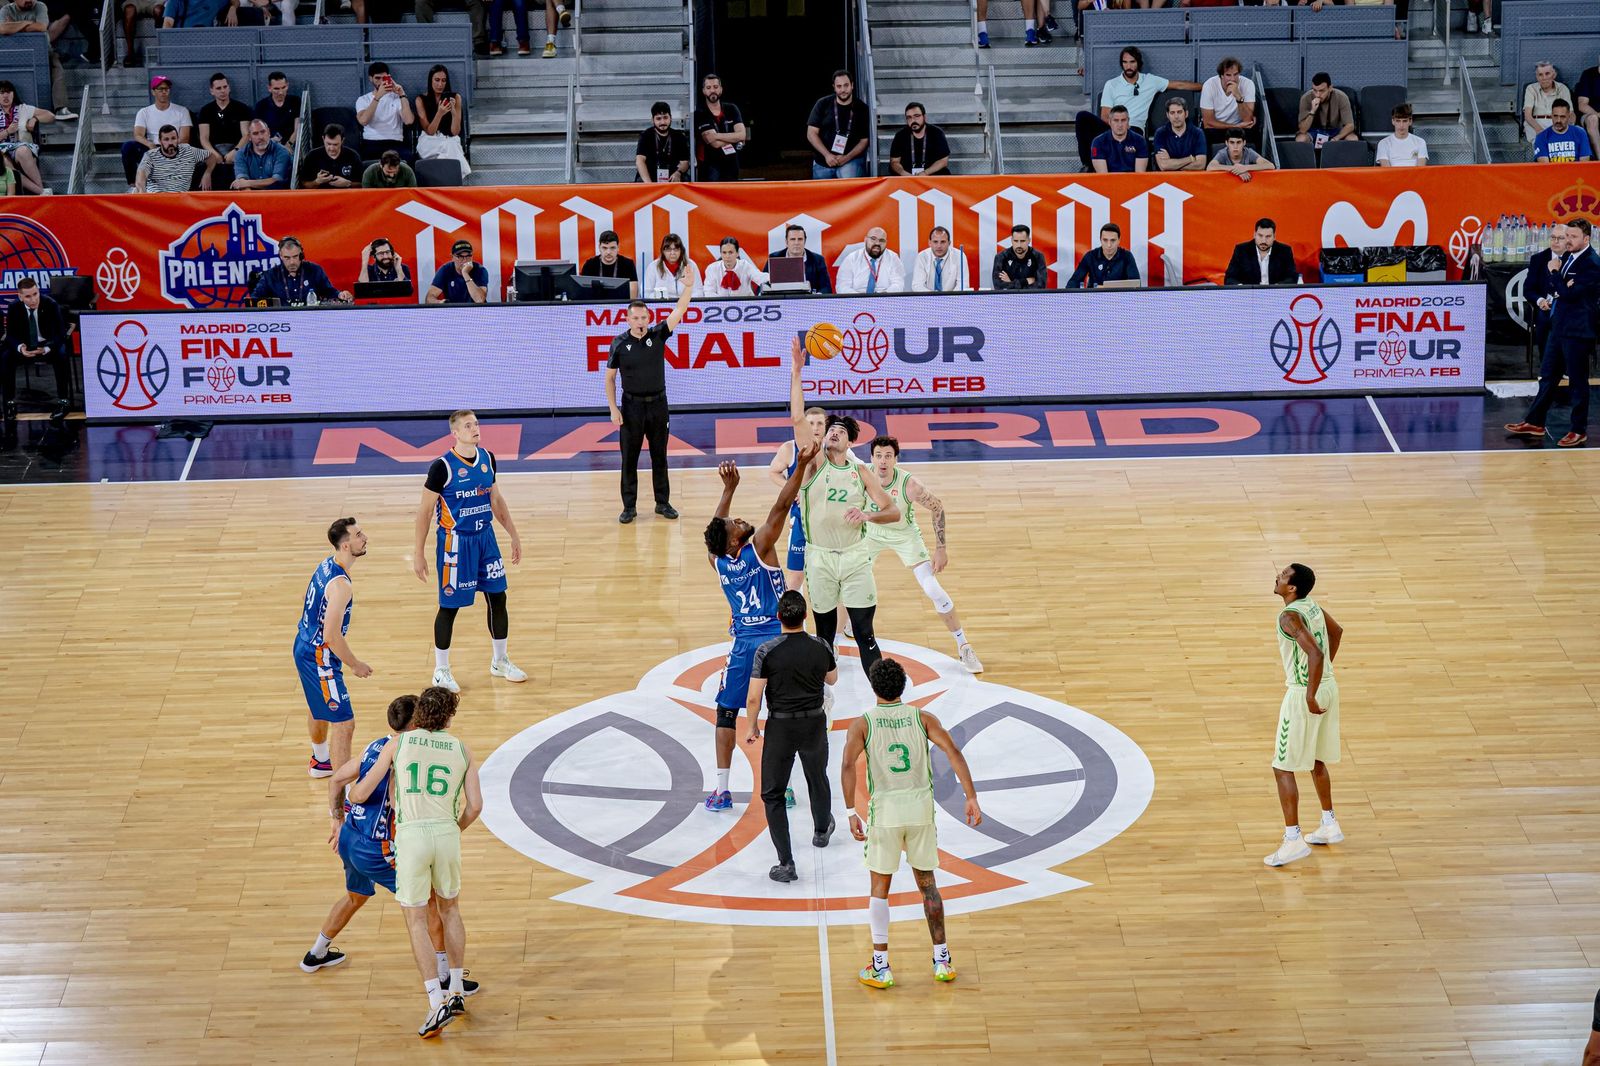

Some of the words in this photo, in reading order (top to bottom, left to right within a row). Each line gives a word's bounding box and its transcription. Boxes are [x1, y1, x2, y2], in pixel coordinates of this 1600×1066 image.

[1548, 141, 1575, 152] NEVER
[1355, 296, 1465, 308] MADRID2025
[180, 322, 291, 334] MADRID2025
[1354, 310, 1465, 334] FINAL
[181, 337, 293, 360] FINAL
[586, 331, 782, 373] FNAL
[1353, 367, 1426, 378] PRIMERA
[1430, 366, 1461, 377] FEB
[801, 377, 925, 396] PRIMERA
[932, 376, 986, 393] FEB
[183, 394, 256, 405] PRIMERA
[260, 393, 292, 403] FEB
[827, 488, 848, 503] 22
[475, 519, 484, 531] 15
[735, 585, 762, 614] 24
[876, 716, 913, 729] HUGHES
[408, 736, 418, 745] DE
[419, 738, 429, 747] LA
[430, 740, 454, 751] TORRE
[888, 743, 911, 773] 3
[405, 762, 451, 797] 16
